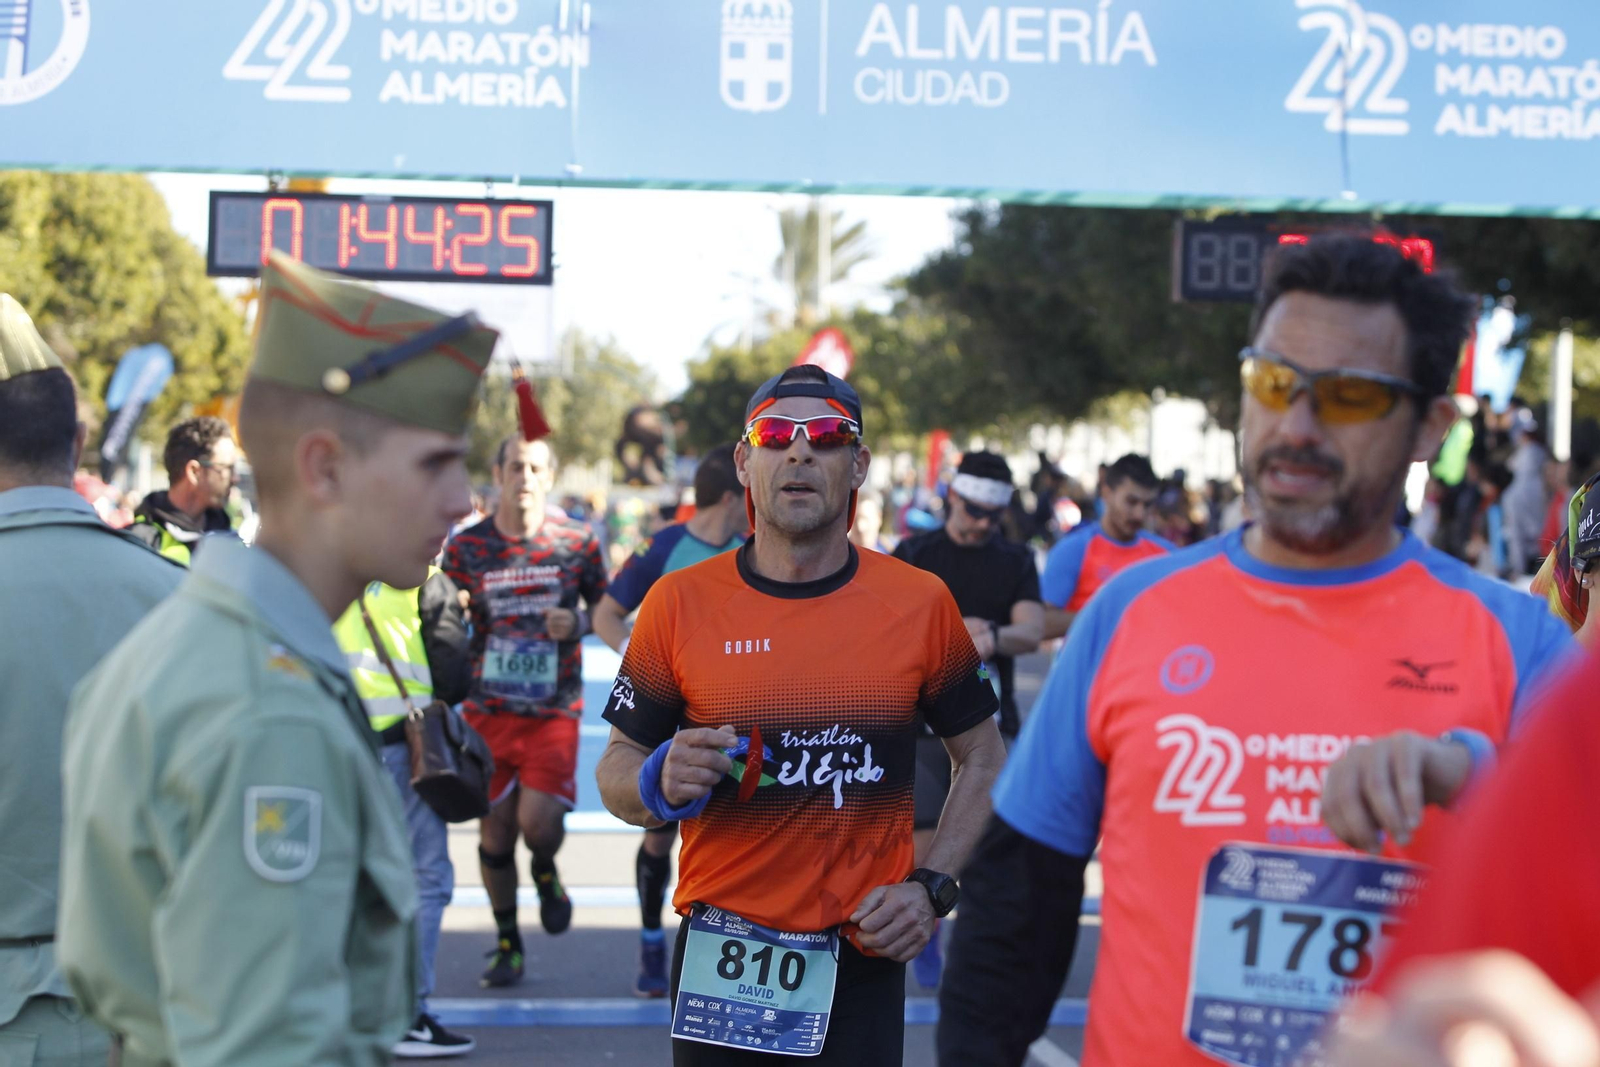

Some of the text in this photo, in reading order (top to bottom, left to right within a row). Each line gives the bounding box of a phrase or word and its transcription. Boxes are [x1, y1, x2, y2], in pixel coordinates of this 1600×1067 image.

[381, 0, 518, 25] MEDIO
[380, 24, 590, 68] MARATÓN
[855, 0, 1158, 67] ALMERÍA
[1435, 22, 1567, 60] MEDIO
[379, 66, 567, 108] ALMERÍA
[854, 67, 1010, 108] CIUDAD
[495, 653, 549, 674] 1698
[725, 638, 771, 654] GOBIK
[781, 724, 863, 748] triatlón
[813, 743, 884, 809] Ejido
[778, 931, 829, 943] MARATÓN
[1230, 905, 1396, 981] 178
[716, 939, 806, 992] 810
[687, 999, 705, 1009] NEXA
[737, 983, 774, 1000] DAVID
